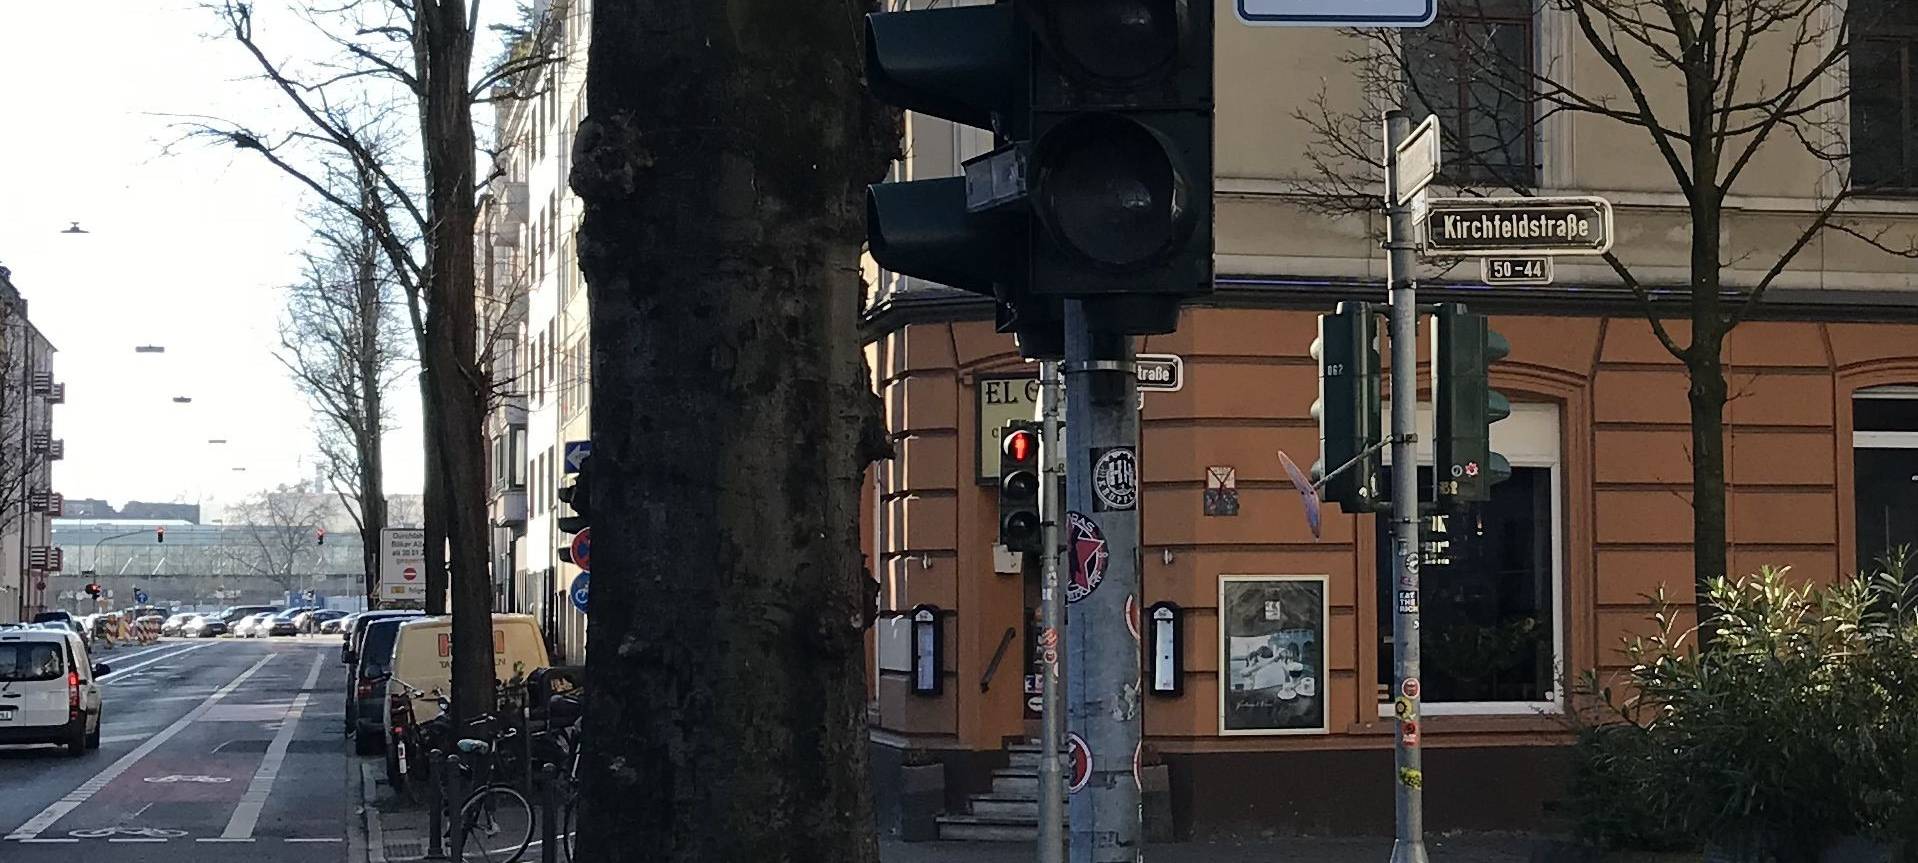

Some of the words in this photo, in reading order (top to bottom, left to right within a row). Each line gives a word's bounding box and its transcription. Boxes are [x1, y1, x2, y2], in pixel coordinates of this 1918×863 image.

[1443, 213, 1589, 241] Kirchfeldstraße
[1137, 364, 1170, 382] traße
[987, 381, 1018, 404] EL
